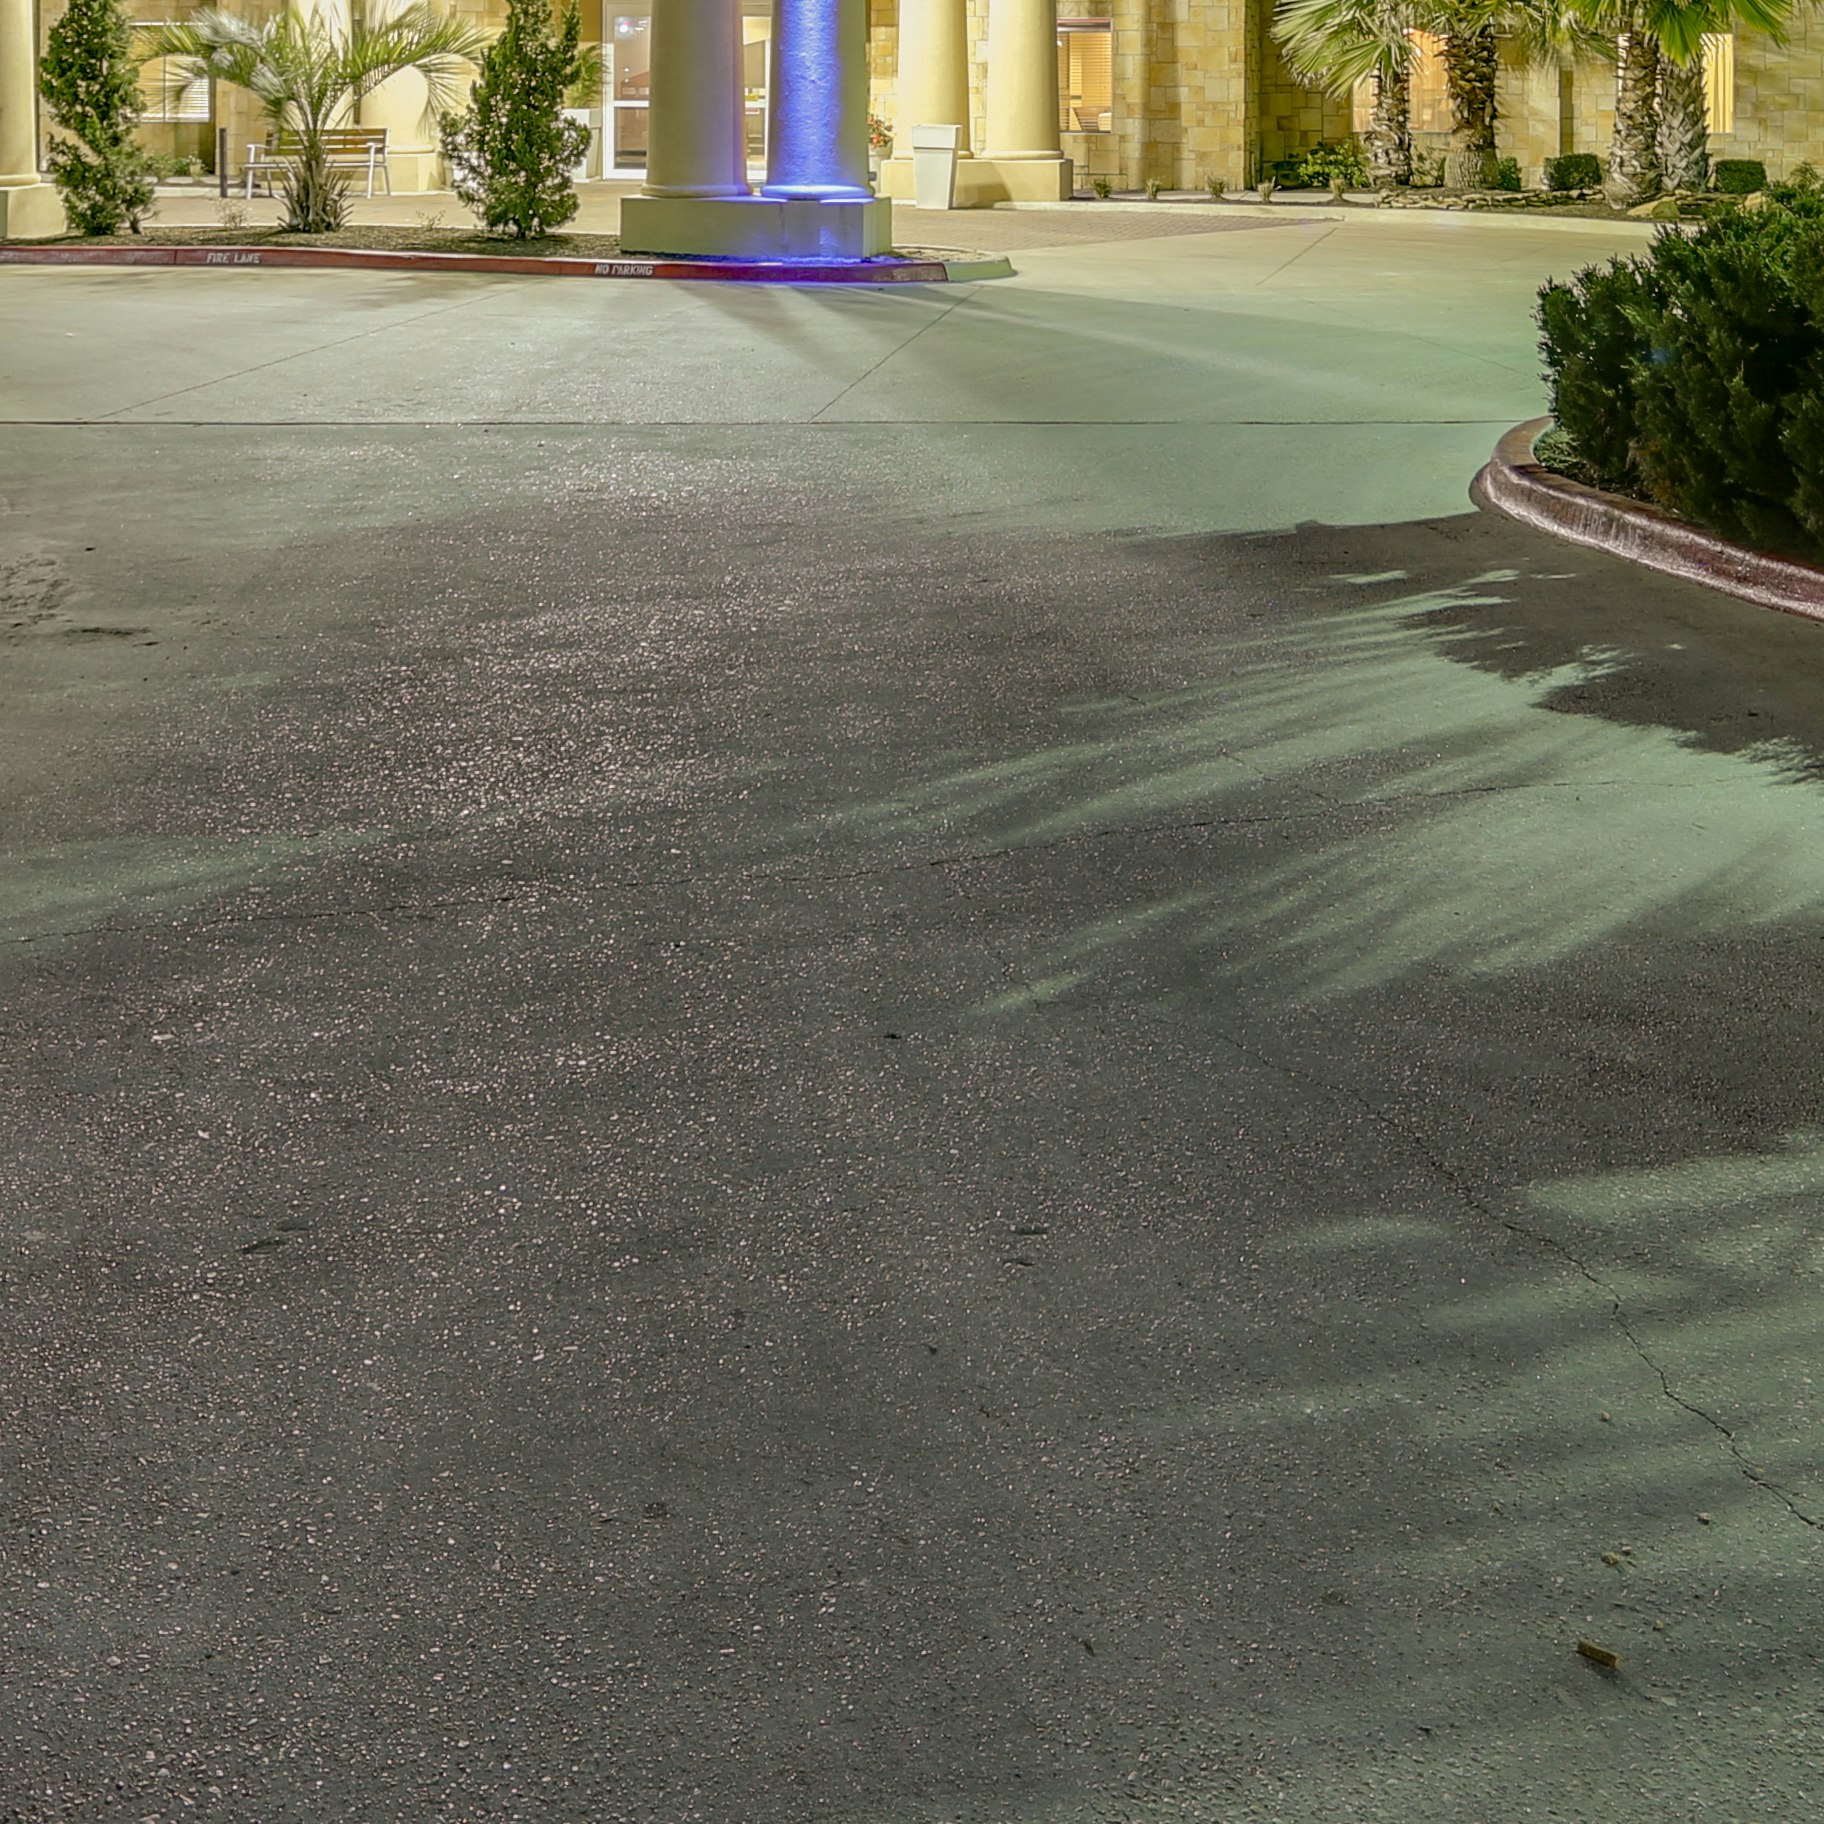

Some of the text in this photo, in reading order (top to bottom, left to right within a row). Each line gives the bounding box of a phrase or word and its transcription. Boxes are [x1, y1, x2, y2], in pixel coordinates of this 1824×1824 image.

[206, 252, 261, 264] FIRE LANE
[595, 263, 653, 276] NO PARKING
